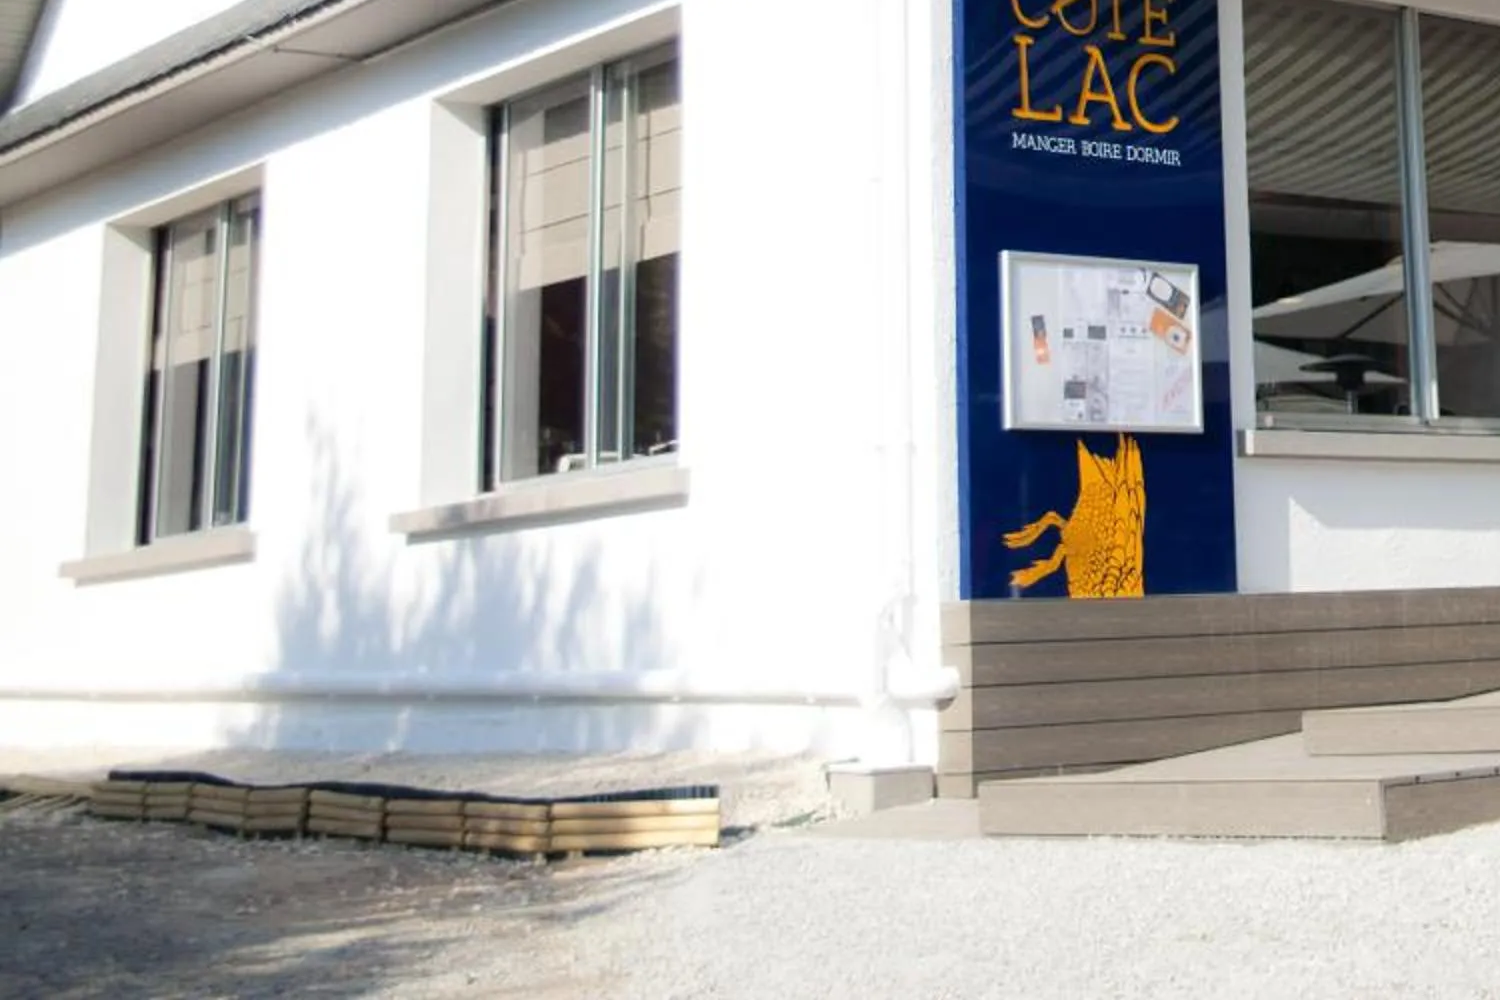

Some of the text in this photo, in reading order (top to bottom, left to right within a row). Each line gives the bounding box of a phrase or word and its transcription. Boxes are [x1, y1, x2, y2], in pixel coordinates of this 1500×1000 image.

[1011, 34, 1180, 134] LAC
[1012, 132, 1181, 167] MANGER BOIRE DORMIR
